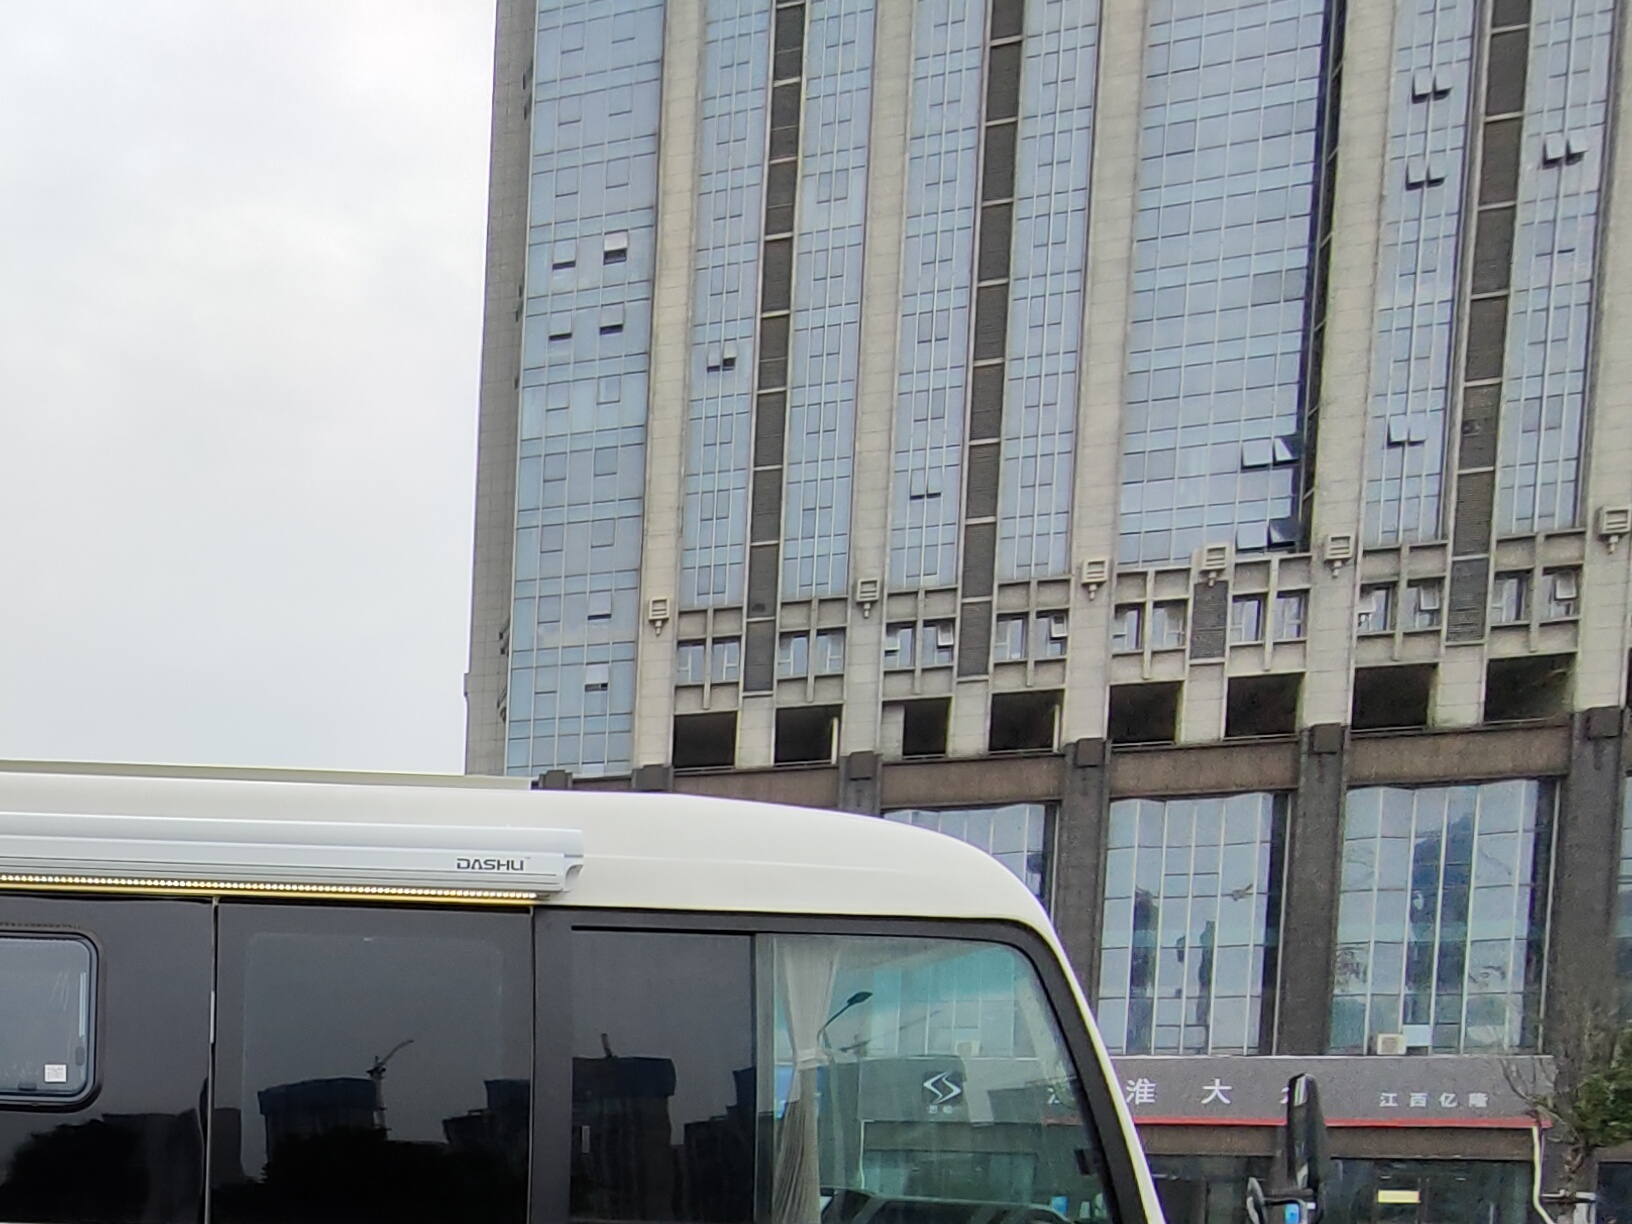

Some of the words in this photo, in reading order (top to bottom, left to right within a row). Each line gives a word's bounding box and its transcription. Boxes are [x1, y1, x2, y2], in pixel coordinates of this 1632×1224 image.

[456, 858, 524, 871] DASHU
[1379, 1092, 1489, 1108] 江西亿隆
